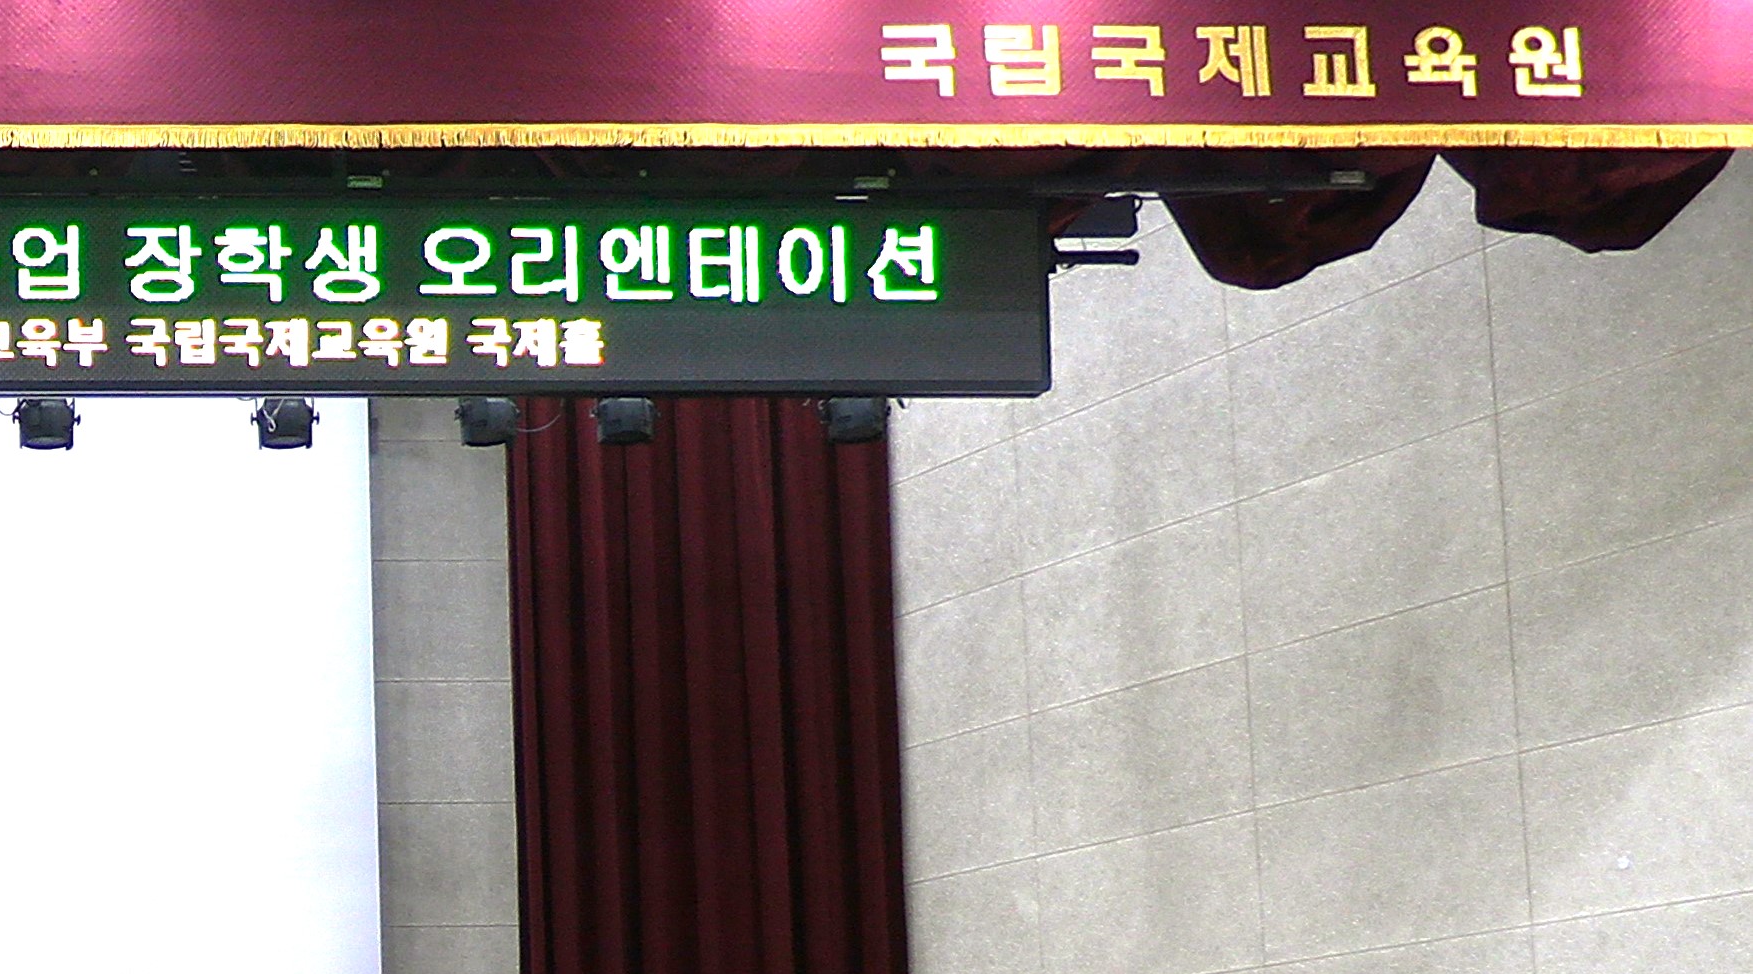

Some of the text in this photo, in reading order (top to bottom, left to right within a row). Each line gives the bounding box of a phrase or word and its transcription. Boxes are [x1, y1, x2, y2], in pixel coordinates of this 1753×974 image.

[879, 23, 1584, 98] 국립국제교육원
[122, 223, 383, 304] 장학생
[417, 223, 940, 304] 오리엔테이션
[124, 317, 449, 368] 국립국제교육원
[465, 317, 606, 368] 국제홀
